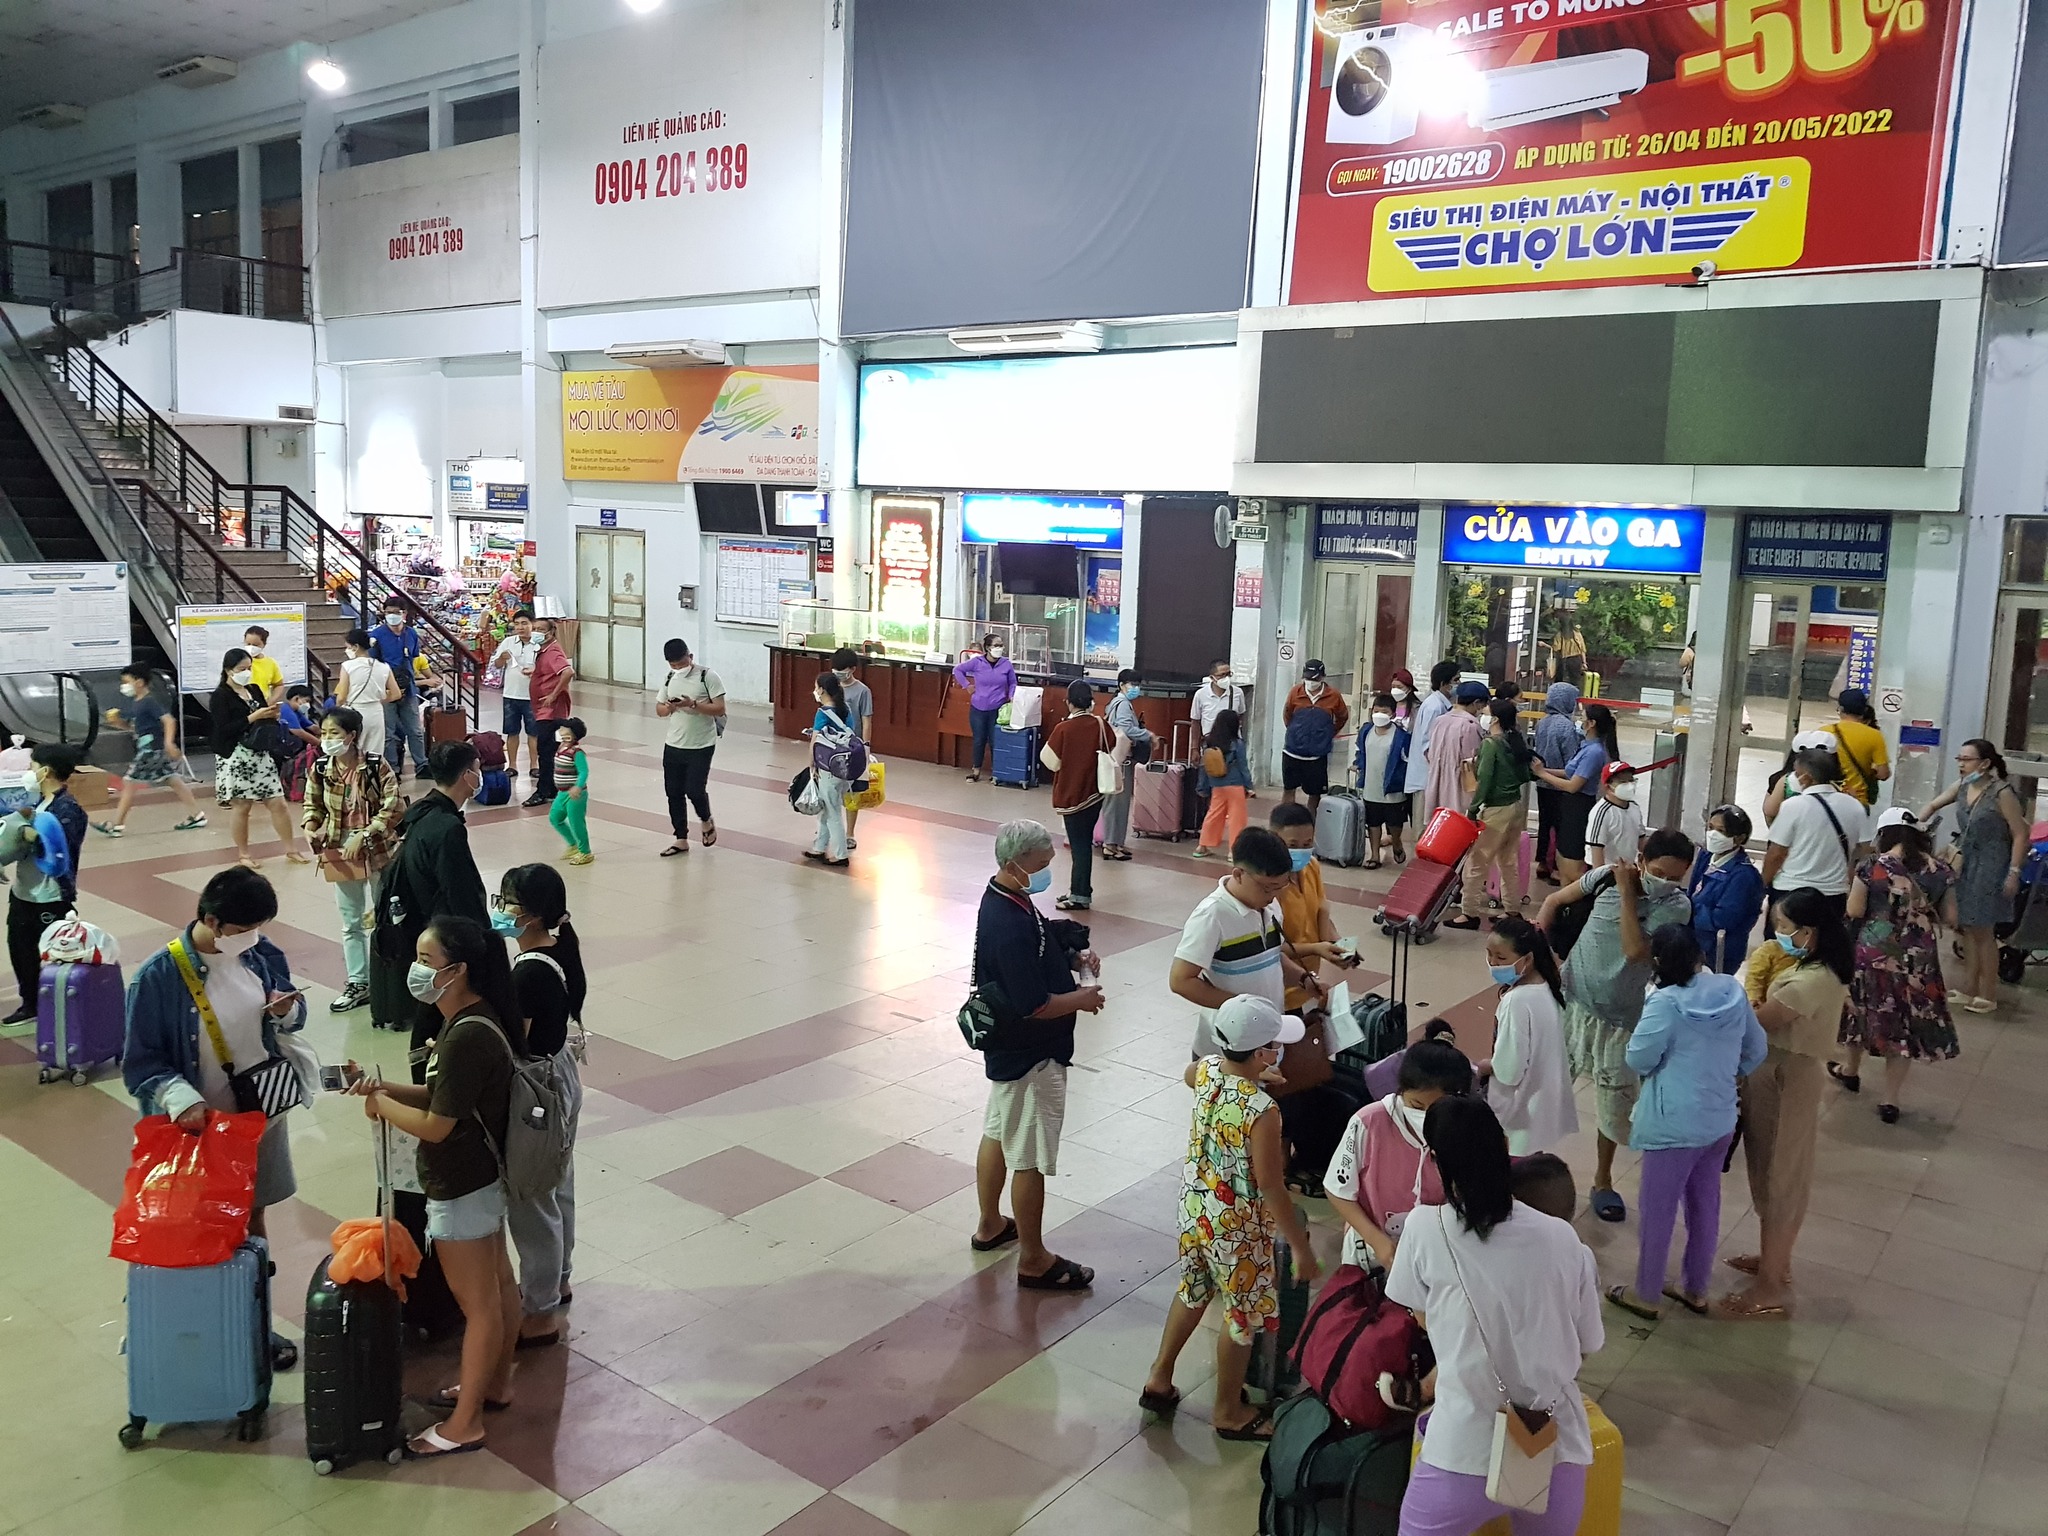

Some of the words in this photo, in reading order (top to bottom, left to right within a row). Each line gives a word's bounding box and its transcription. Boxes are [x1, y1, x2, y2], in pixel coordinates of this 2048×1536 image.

[1511, 0, 1549, 23] TO
[623, 122, 644, 144] LIÊN
[648, 118, 660, 143] HỆ
[664, 111, 697, 140] QUẢNG
[1514, 144, 1540, 170] ÁP
[1544, 143, 1596, 170] DỤNG
[1602, 134, 1631, 160] TỪ:
[1637, 128, 1701, 157] 26/04
[1705, 118, 1748, 150] ĐẾN
[1752, 108, 1894, 145] 20/05/2022
[595, 158, 647, 205] 0904
[656, 151, 697, 198] 204
[705, 143, 749, 192] 389
[1337, 169, 1352, 189] GỌI
[1353, 167, 1380, 183] NGAY:
[1383, 149, 1493, 186] 19002628
[1388, 209, 1437, 233] SIÊU
[1446, 206, 1483, 231] THỊ
[1490, 196, 1548, 226] ĐIỆN
[1556, 188, 1612, 216] MÁY
[1640, 183, 1690, 209] NỘI
[1701, 174, 1772, 203] THẤT
[389, 236, 415, 260] 0904
[419, 232, 439, 256] 204
[443, 228, 463, 253] 389
[1464, 228, 1560, 271] CHỢ
[1567, 214, 1667, 259] LỚN
[568, 381, 591, 401] MUA
[592, 375, 605, 401] VÉ
[606, 375, 627, 400] TÀU
[569, 409, 593, 436] MỌI
[625, 408, 651, 436] MỌI
[654, 407, 680, 431] NƠI
[1322, 507, 1345, 525] KHÁCH
[1401, 511, 1416, 530] HẠN
[1464, 506, 1534, 543] CỬA
[1544, 511, 1619, 546] VÀO
[1626, 517, 1682, 548] GA
[820, 540, 831, 548] WC
[1319, 537, 1331, 554] TẠI
[1397, 537, 1417, 556] SOÁT
[1525, 546, 1610, 566] ENTRY
